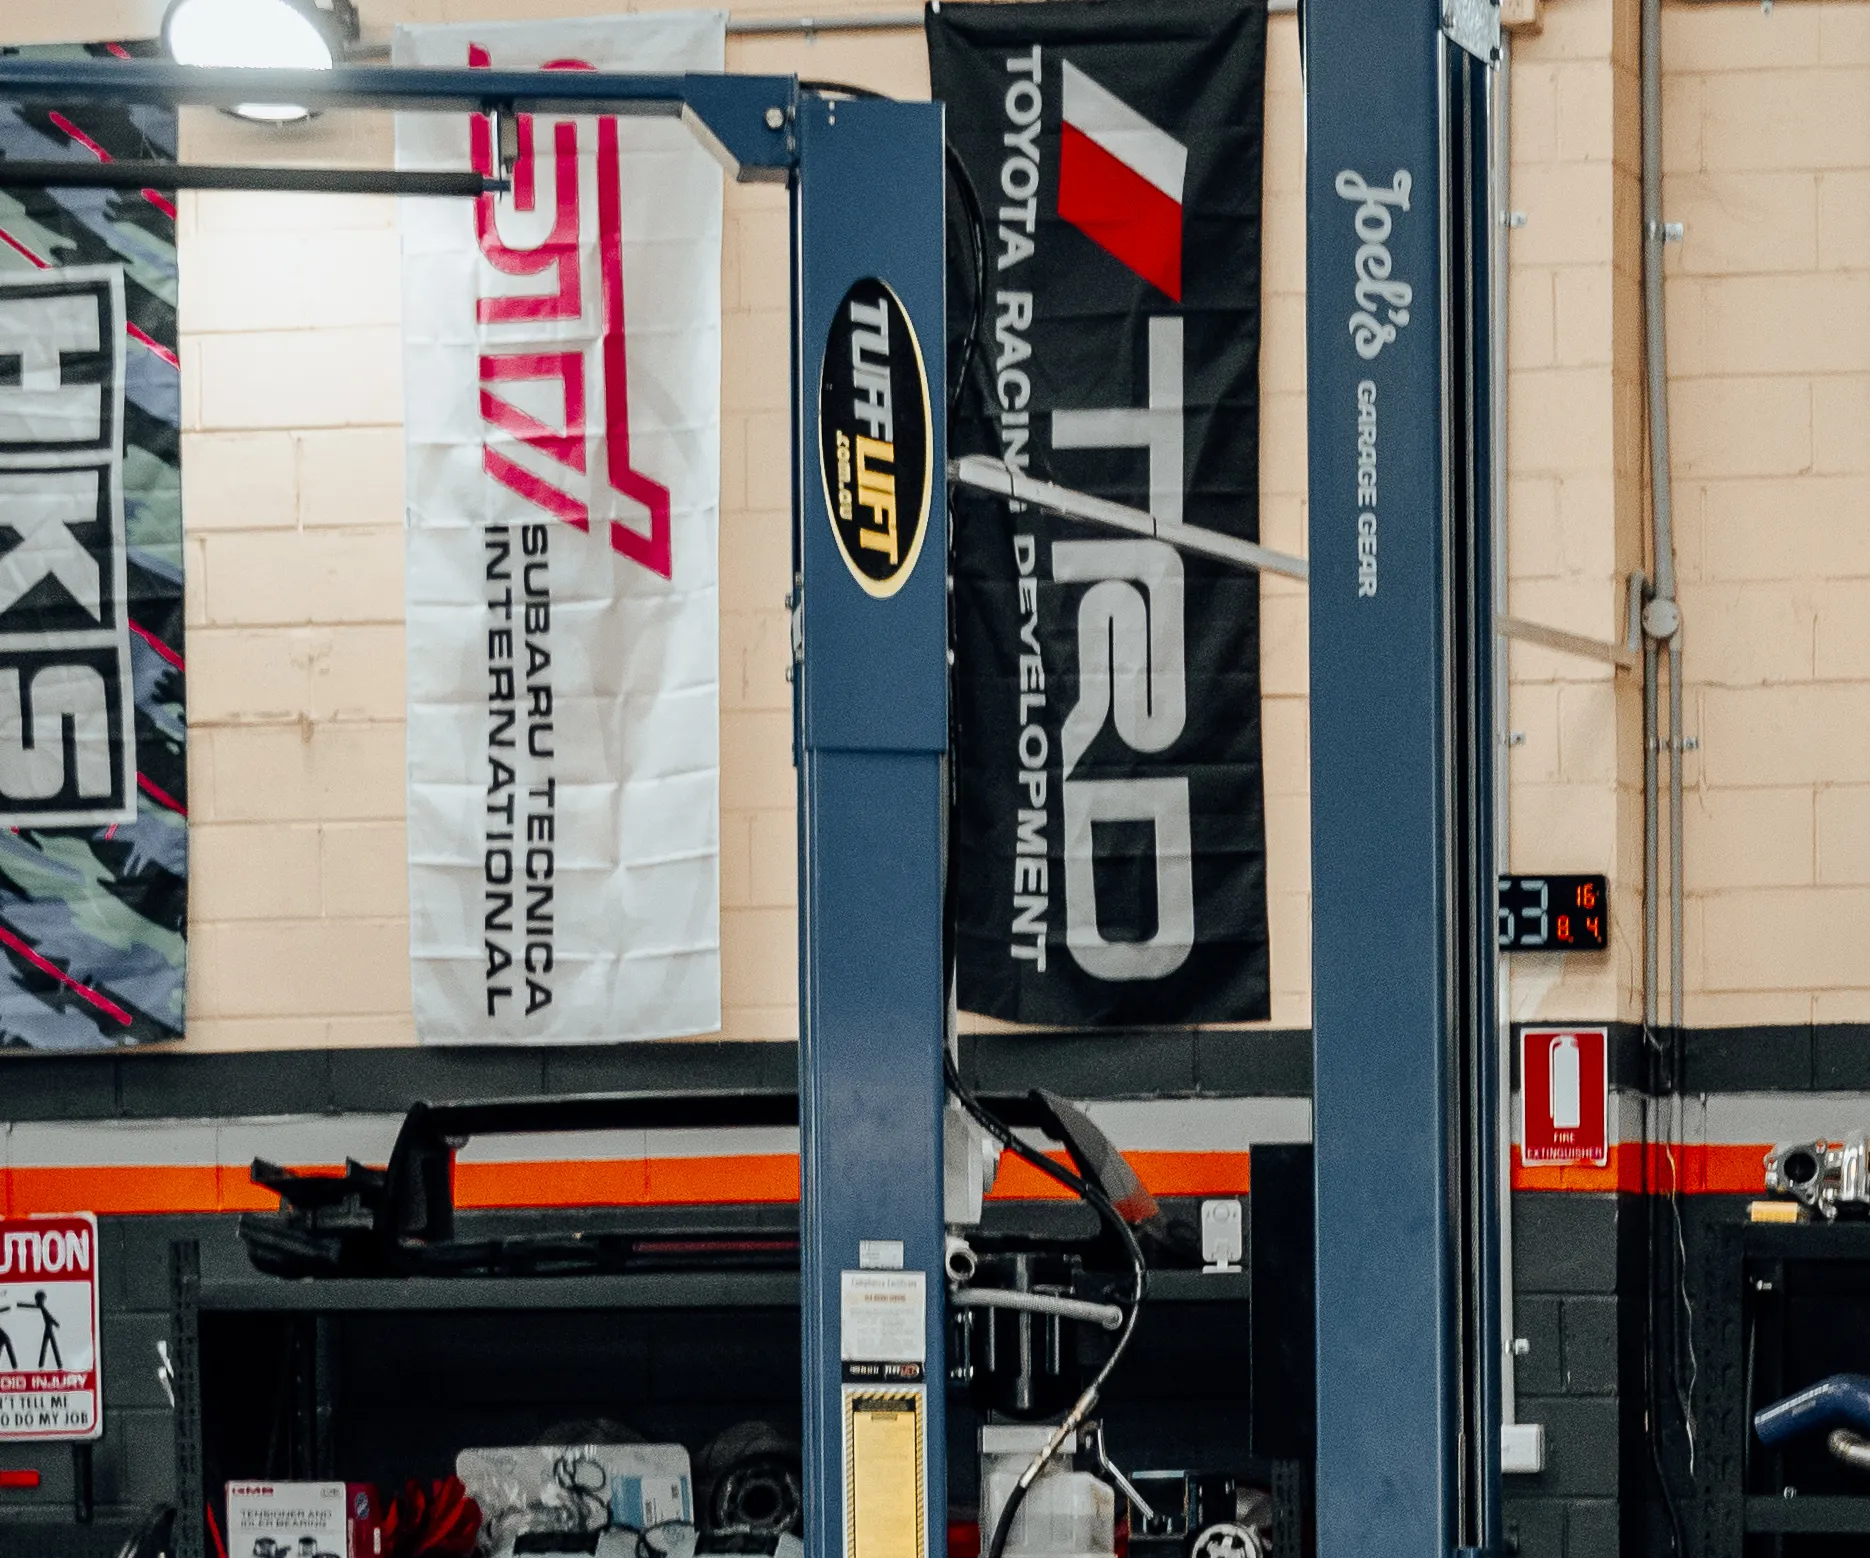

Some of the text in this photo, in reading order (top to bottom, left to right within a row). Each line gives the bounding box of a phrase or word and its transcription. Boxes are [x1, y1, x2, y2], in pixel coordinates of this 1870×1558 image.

[1335, 169, 1413, 360] Joel's
[0, 294, 111, 798] HKS
[996, 45, 1047, 973] TOYOTA RACIN DEVELOPMENT
[1357, 380, 1379, 598] GARAGE GEAR
[1051, 315, 1195, 982] TRD
[484, 526, 520, 1018] INTERNATIONAL
[521, 524, 555, 1017] SUBARU TECNICA
[1526, 1147, 1603, 1160] EXTINGUISHER
[1553, 1131, 1576, 1144] FIRE
[15, 1411, 34, 1427] DO
[39, 1410, 59, 1426] MY
[64, 1410, 88, 1425] JOB
[31, 1373, 88, 1390] INJURY
